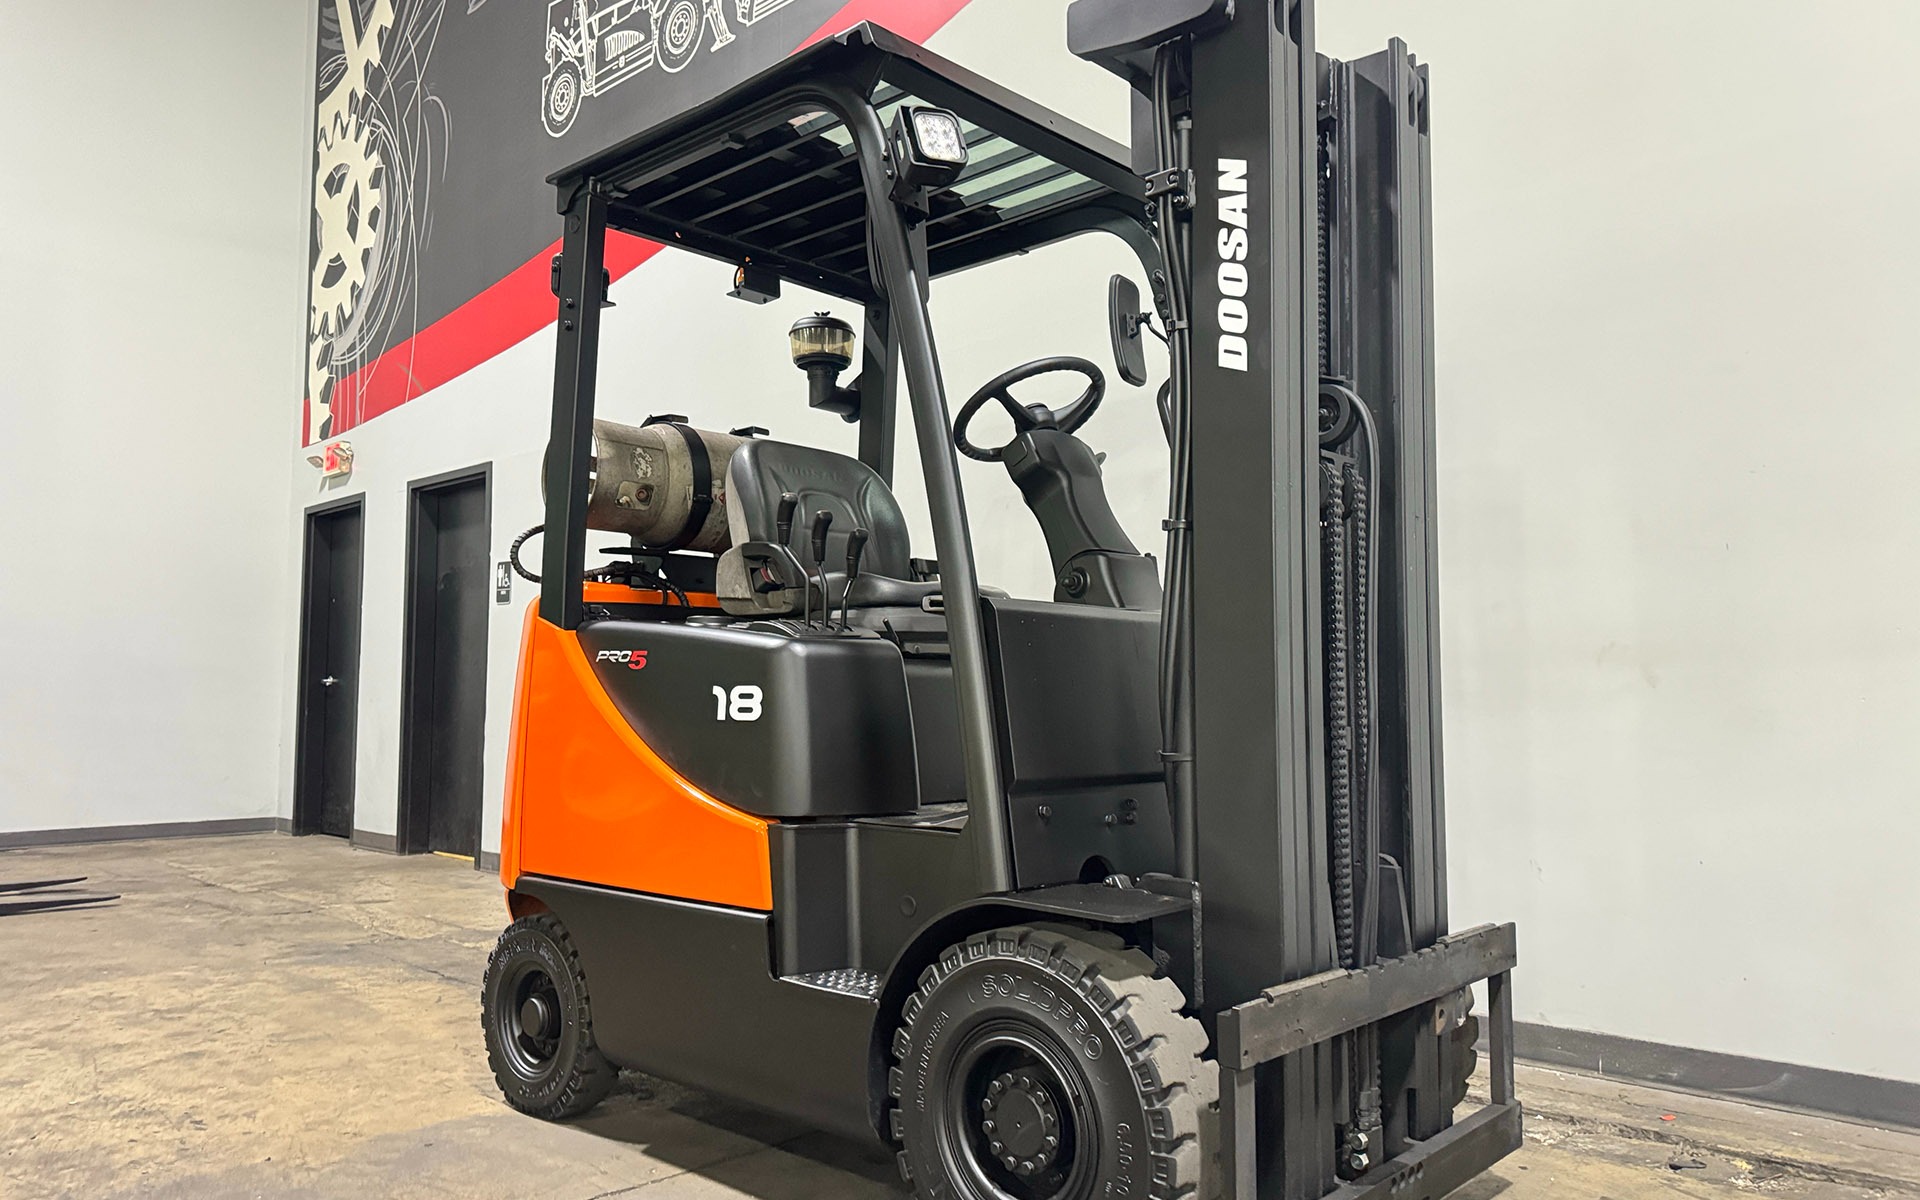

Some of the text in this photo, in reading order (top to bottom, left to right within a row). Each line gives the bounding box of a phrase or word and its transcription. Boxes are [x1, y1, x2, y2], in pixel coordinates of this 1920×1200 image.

[1217, 158, 1249, 372] DOOSAN
[596, 650, 648, 670] PRO5
[712, 685, 763, 721] 18
[981, 973, 1103, 1061] SOLIDPRO
